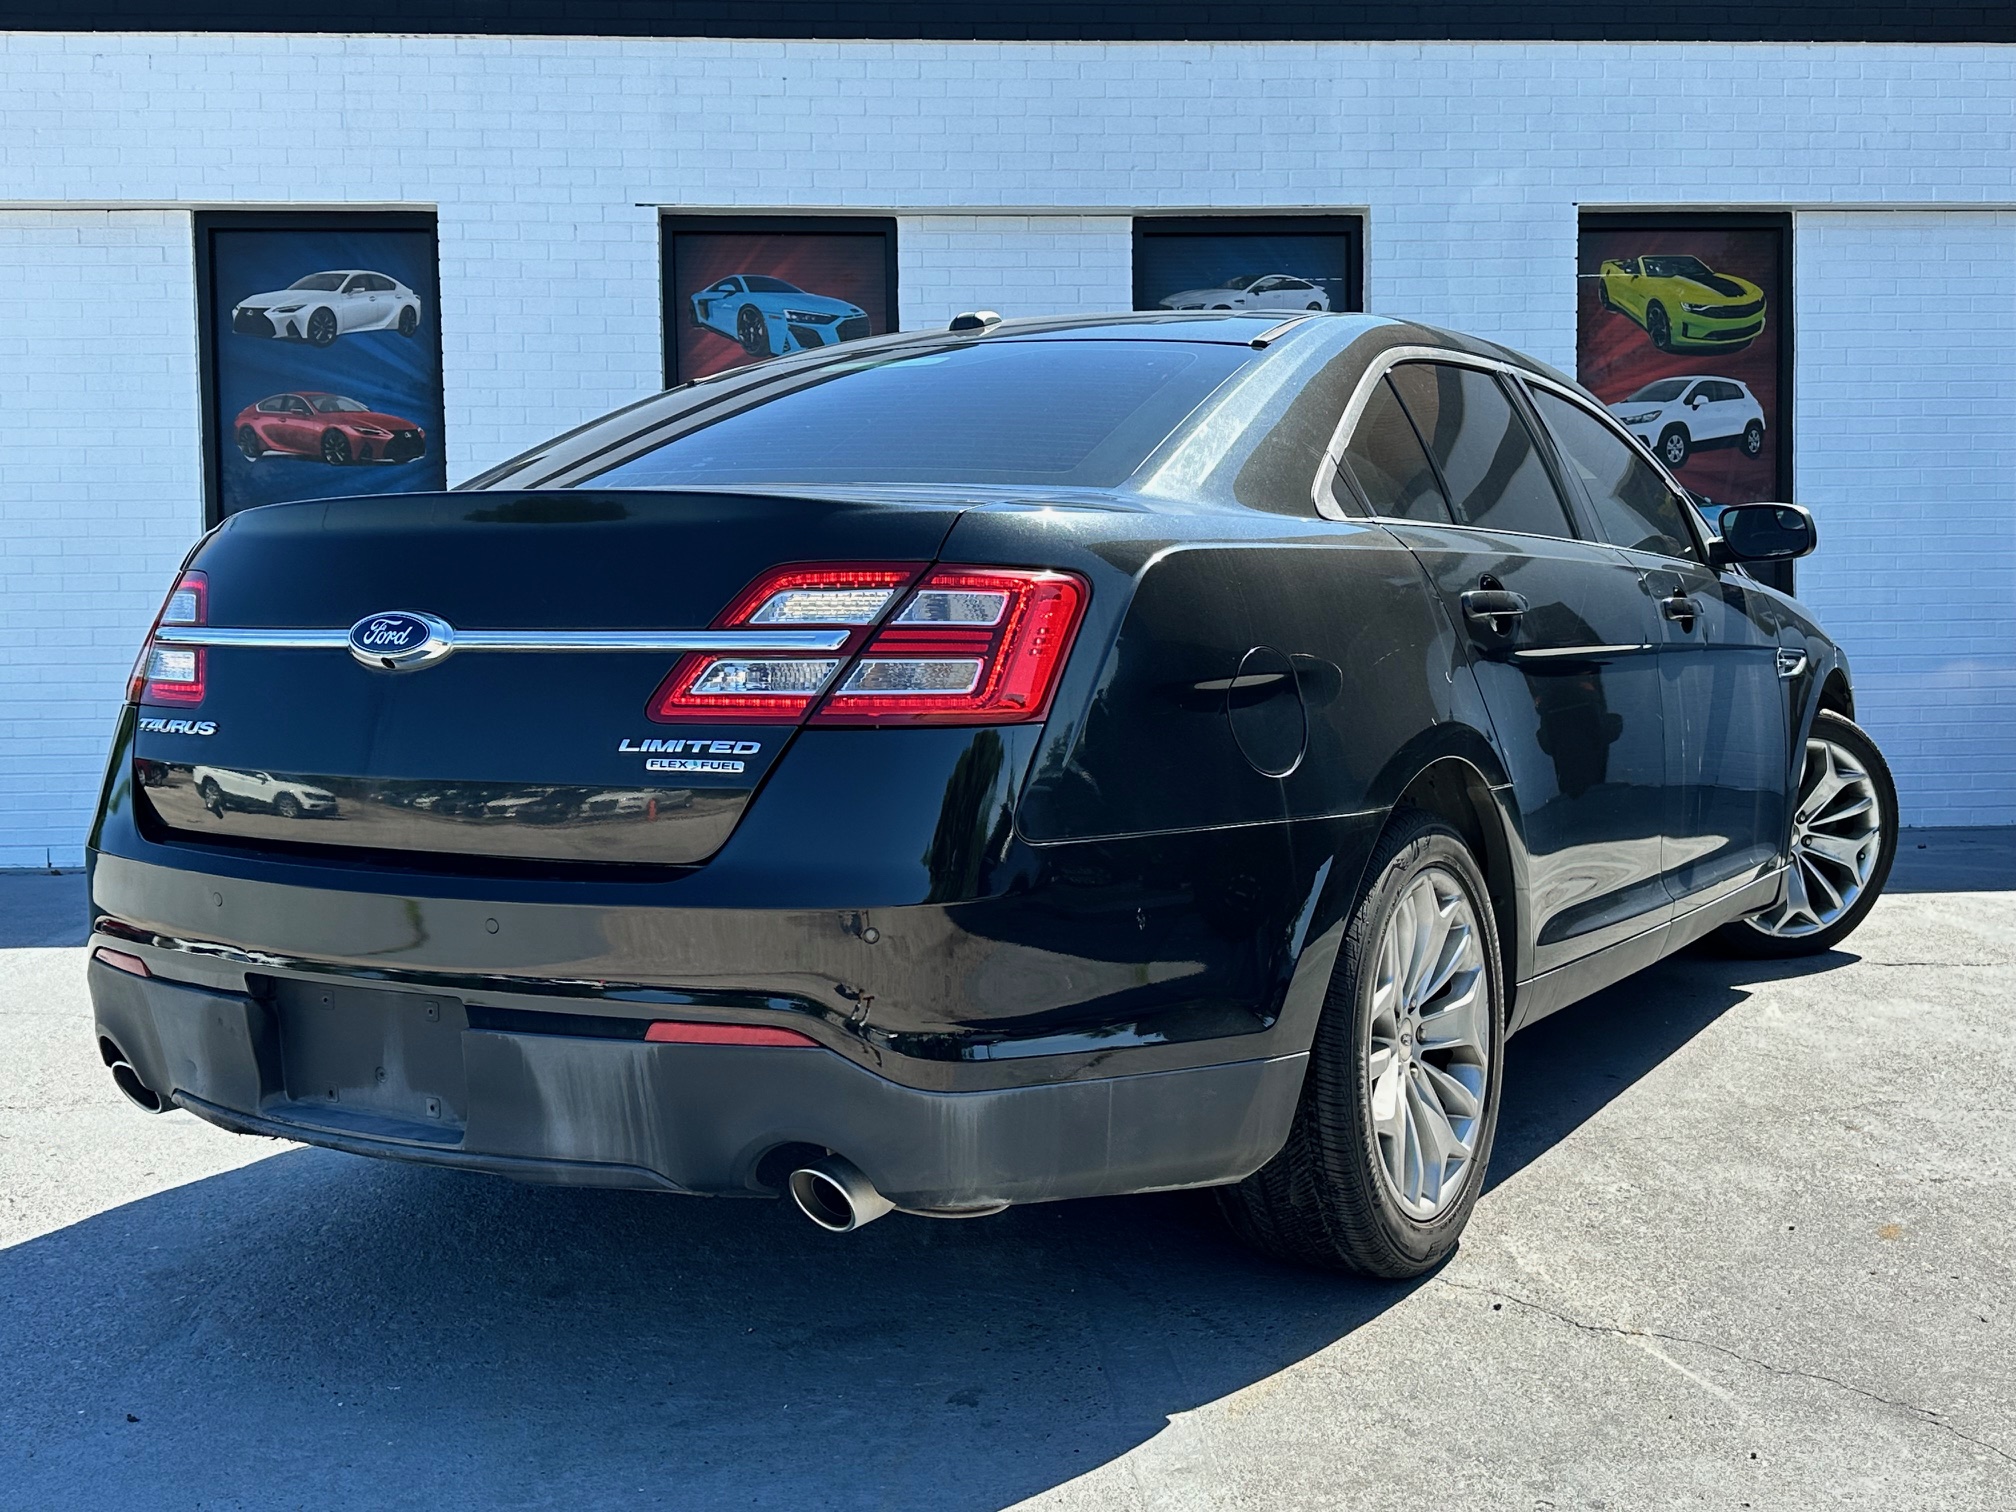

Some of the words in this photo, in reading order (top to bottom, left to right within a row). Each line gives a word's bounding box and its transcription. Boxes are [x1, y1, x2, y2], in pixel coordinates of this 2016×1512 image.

[363, 618, 413, 645] Ford
[139, 718, 217, 736] TAURUS
[618, 738, 761, 754] LIMITED
[650, 760, 688, 769] FLEX
[700, 761, 740, 770] FUEL
